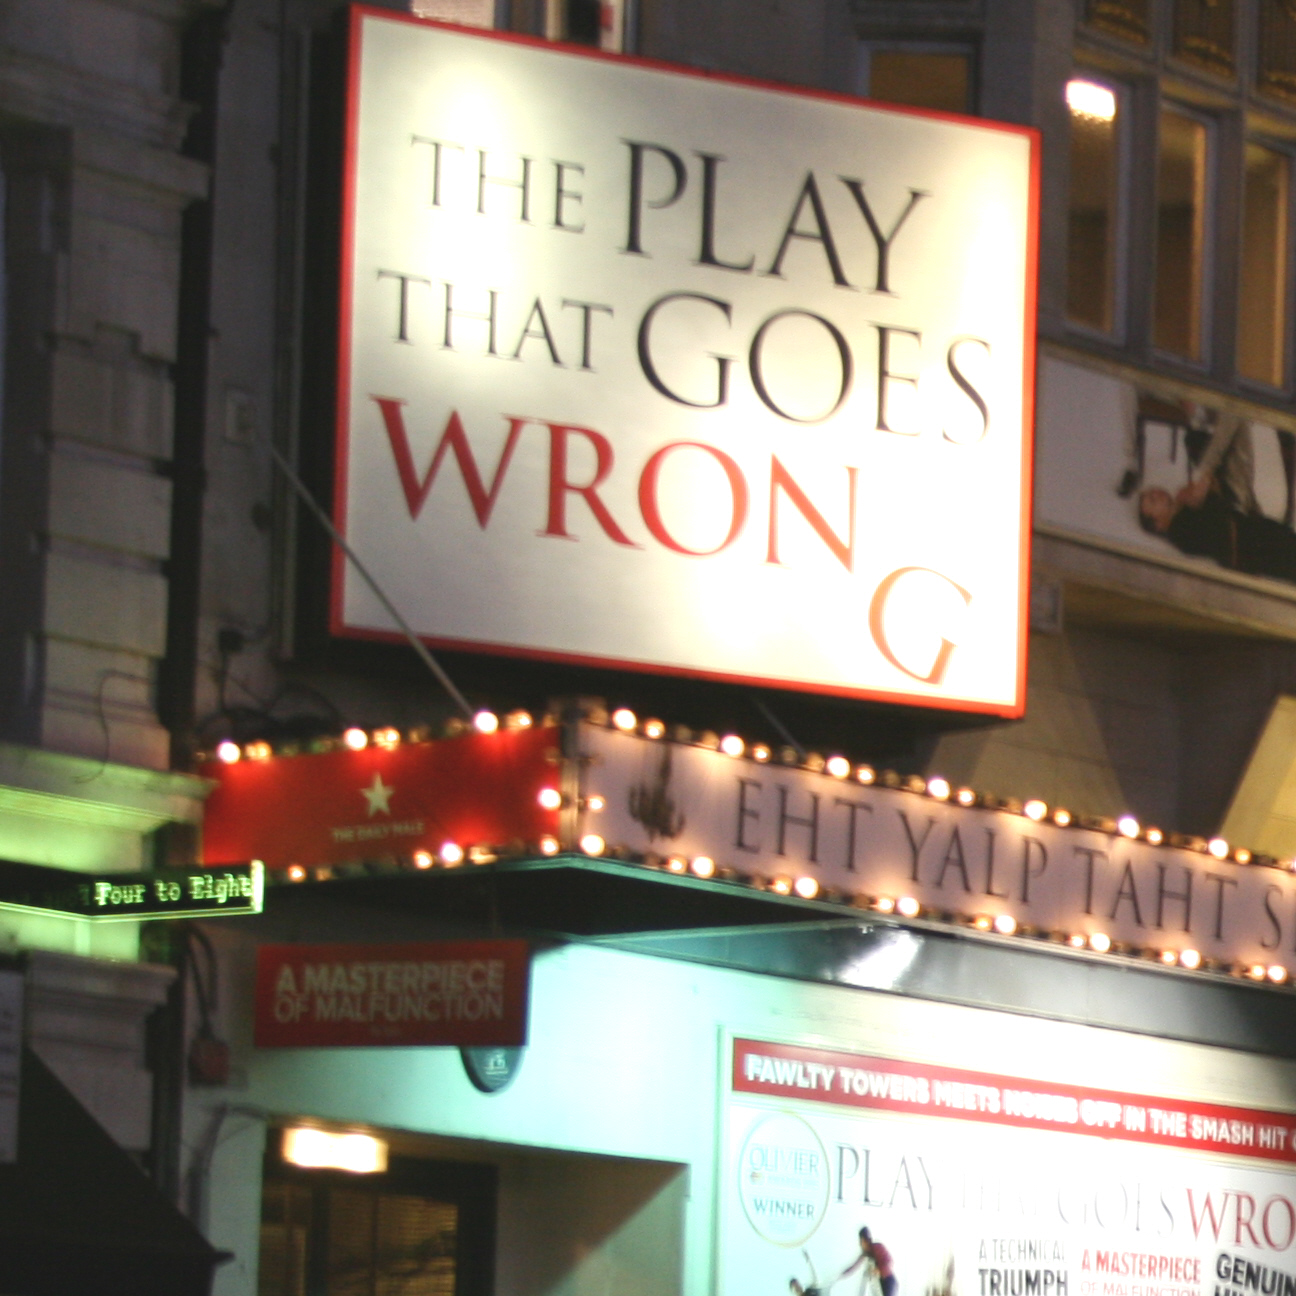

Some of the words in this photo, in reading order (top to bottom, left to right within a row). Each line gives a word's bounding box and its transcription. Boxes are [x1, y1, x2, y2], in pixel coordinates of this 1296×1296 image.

[411, 134, 586, 235] THE
[617, 138, 932, 298] PLAY
[376, 268, 614, 373] THAT
[635, 291, 992, 446] GOES
[735, 776, 873, 871] EHT
[896, 807, 1048, 904] YALP
[1073, 845, 1238, 943] TAHT
[94, 882, 146, 907] Four
[154, 878, 182, 902] to
[276, 963, 298, 993] A
[303, 959, 504, 994] MASTERPIECE
[274, 993, 309, 1024] OF
[314, 990, 504, 1023] MALFUNCTION
[744, 1053, 836, 1092] FAWLTY
[838, 1067, 931, 1105] TOWERS
[1149, 1108, 1188, 1139] THE
[1191, 1114, 1255, 1148] SMASH
[1258, 1126, 1288, 1151] HIT
[834, 1143, 936, 1212] PLAY
[753, 1199, 816, 1220] WINNER
[978, 1238, 988, 1262] A
[992, 1238, 1067, 1264] TECHNICAL
[1081, 1248, 1091, 1272] A
[1095, 1249, 1202, 1285] MASTERPIECE
